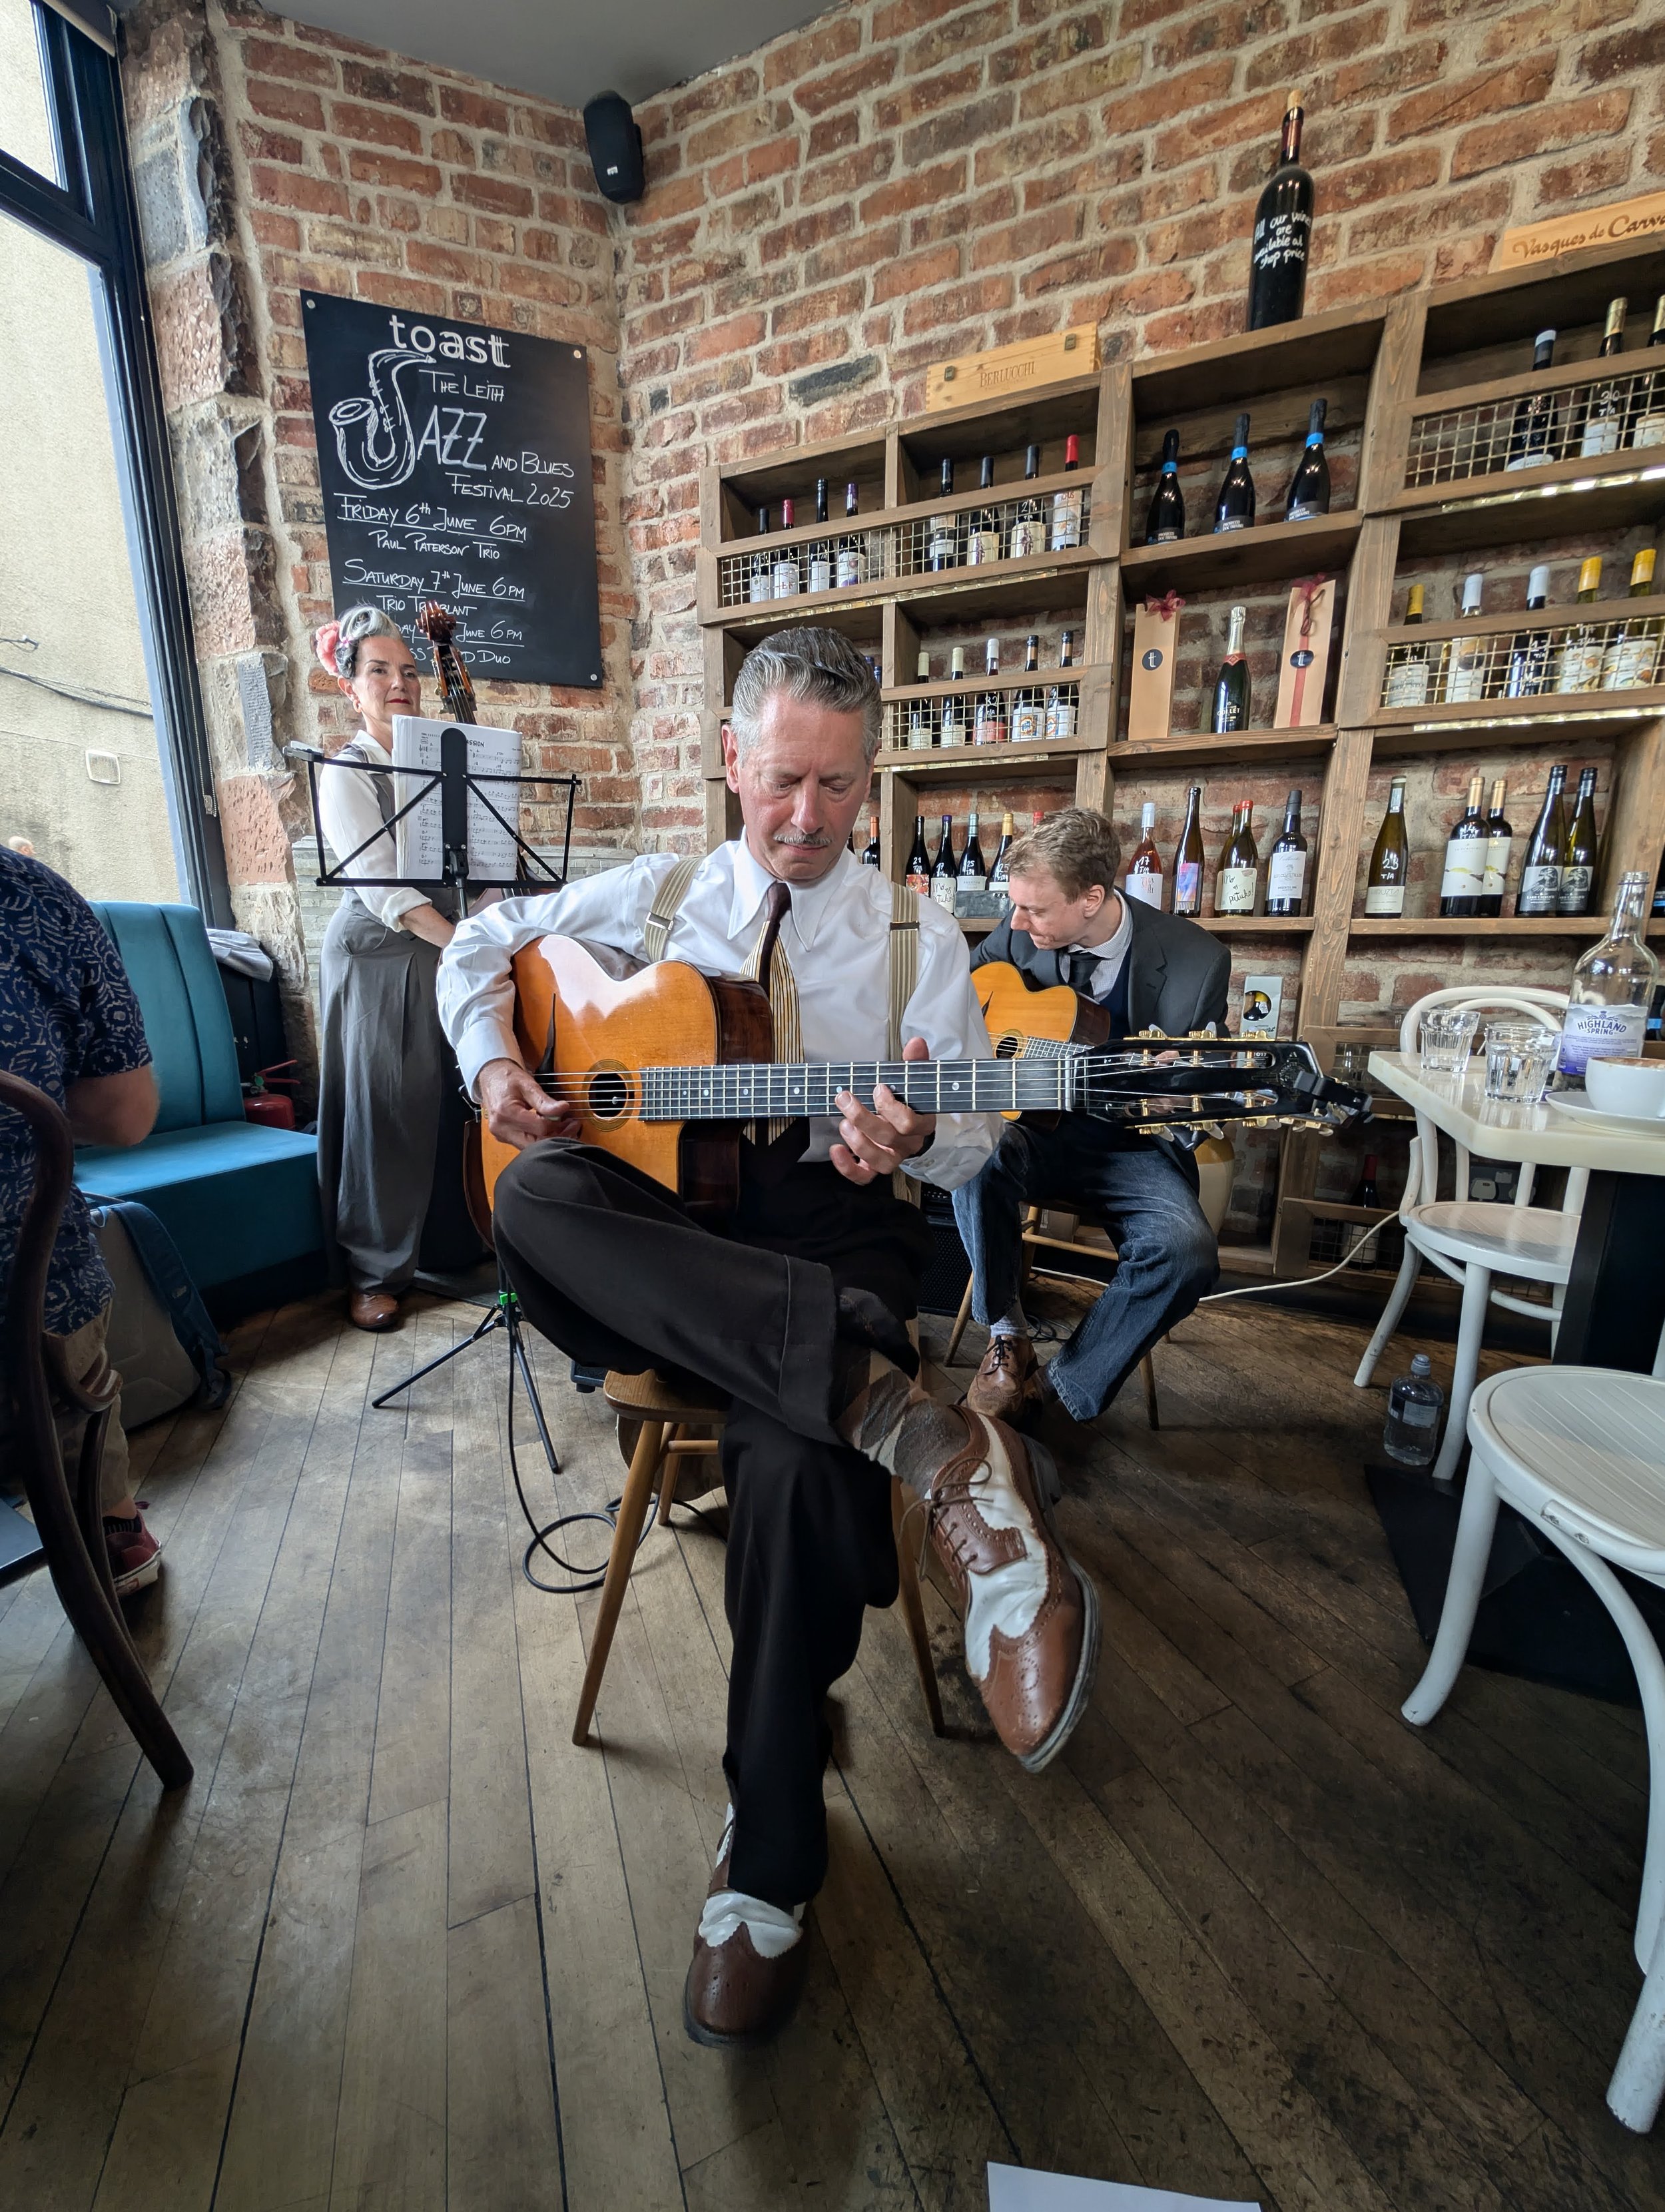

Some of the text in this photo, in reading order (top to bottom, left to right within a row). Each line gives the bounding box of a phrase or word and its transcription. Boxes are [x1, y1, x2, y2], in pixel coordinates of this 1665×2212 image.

[1253, 217, 1266, 245] All
[1269, 214, 1289, 229] our
[1275, 224, 1293, 236] are
[1512, 233, 1586, 258] Vasques
[1589, 222, 1605, 240] de
[1253, 234, 1291, 264] available
[1259, 250, 1281, 270] shop
[389, 314, 511, 368] toast
[980, 360, 1036, 388] BERLUCCHI
[491, 454, 518, 471] AND
[521, 451, 575, 478] BLUES
[526, 482, 575, 509] 2025
[434, 507, 478, 532] JUNE
[368, 530, 407, 551] PAUL
[404, 532, 470, 556] PATERSON
[343, 558, 425, 595] SATURDAY
[451, 573, 487, 599] JUNE
[456, 621, 486, 643] JUNE
[1577, 1020, 1627, 1033] HIGHLAND
